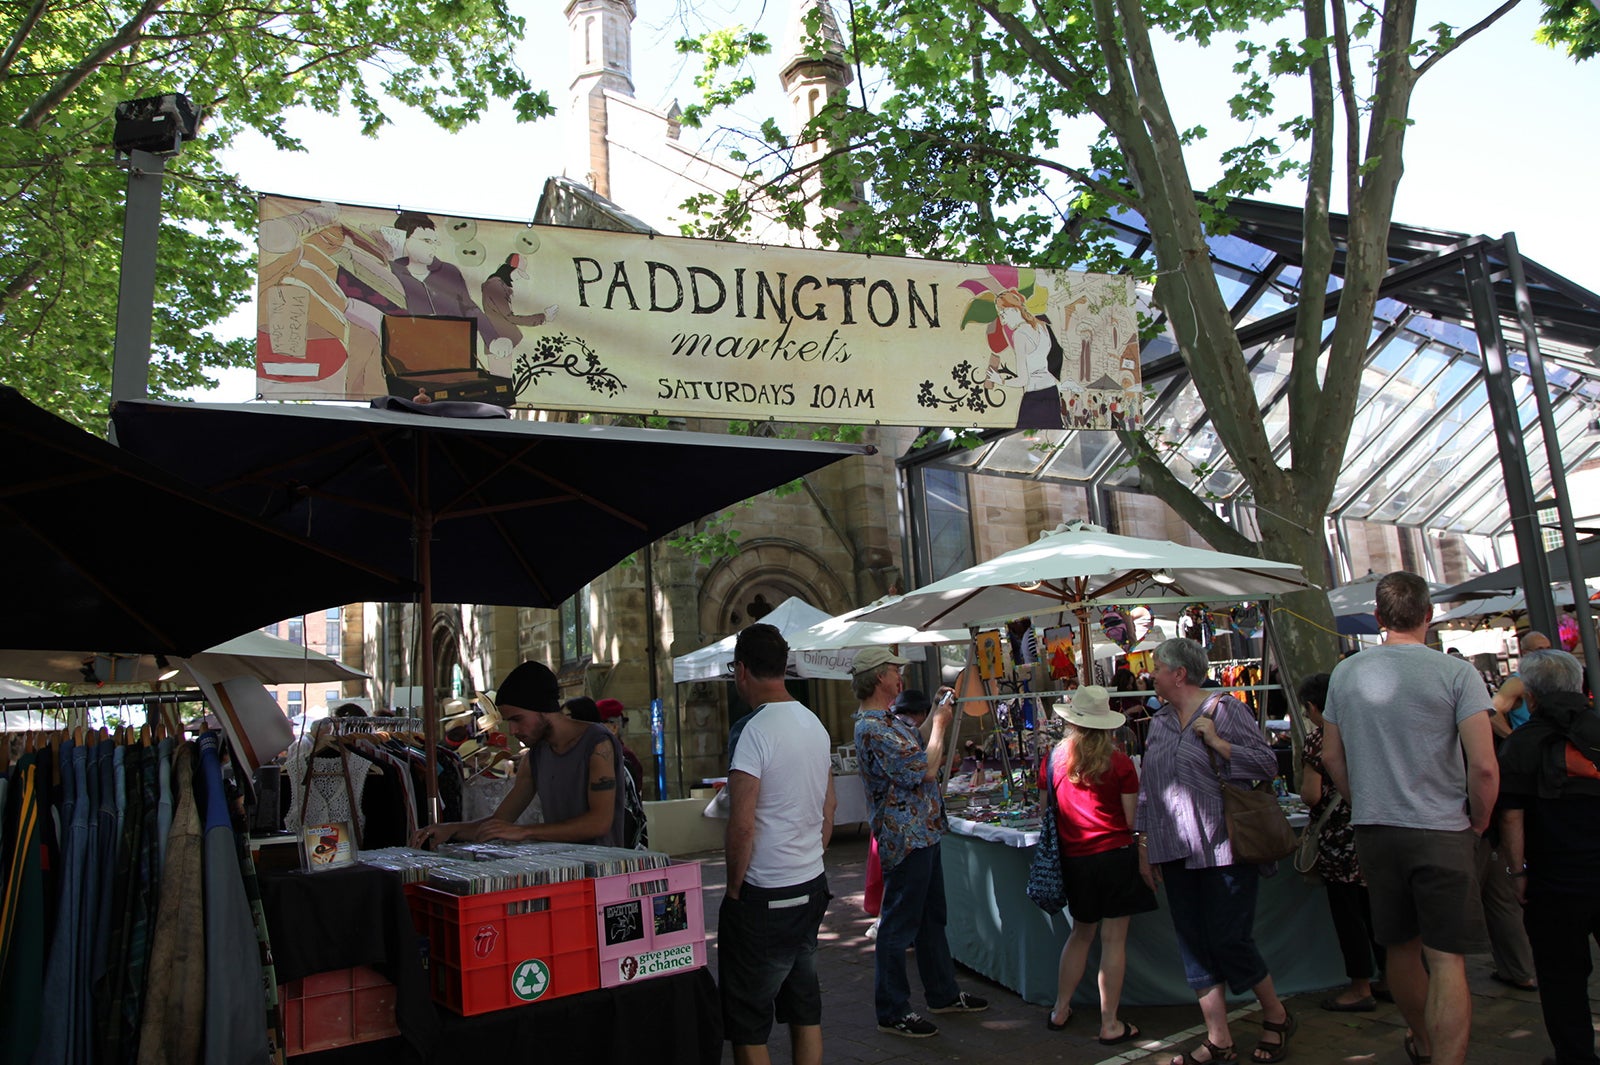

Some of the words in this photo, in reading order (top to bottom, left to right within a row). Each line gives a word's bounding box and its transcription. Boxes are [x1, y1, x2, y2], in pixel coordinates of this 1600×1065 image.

[572, 256, 941, 329] PADDINGTON
[670, 316, 853, 363] markets
[657, 377, 795, 406] SATURDAYS
[809, 383, 875, 410] 10AM
[803, 650, 853, 670] bilingua
[639, 952, 662, 965] give
[663, 945, 691, 960] peace
[639, 966, 647, 975] a
[648, 955, 692, 973] chance
